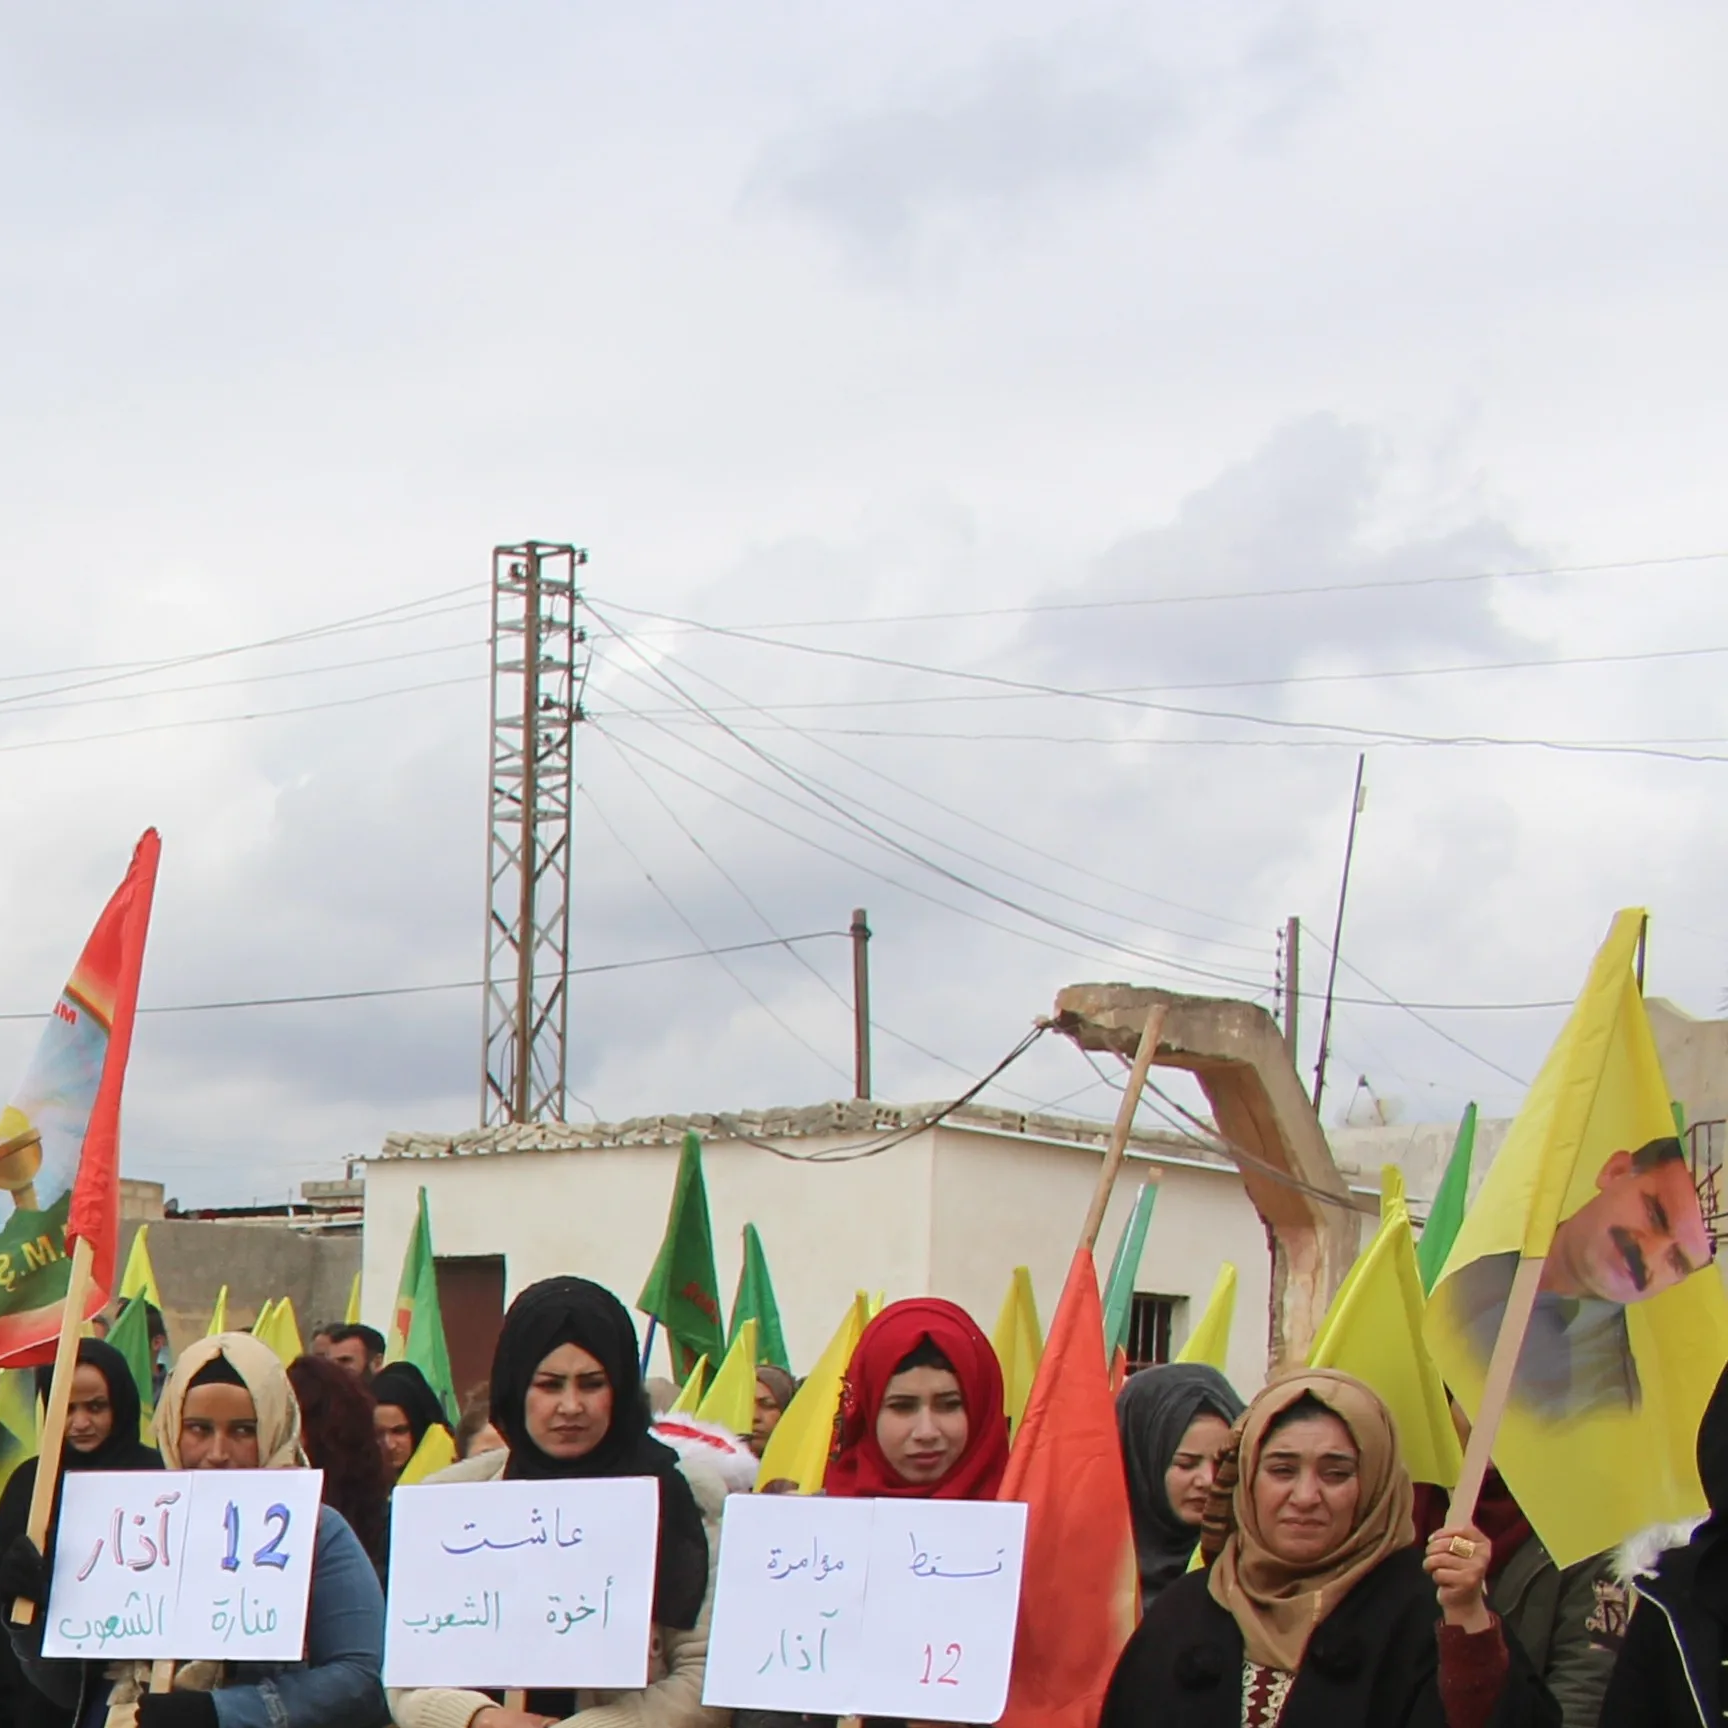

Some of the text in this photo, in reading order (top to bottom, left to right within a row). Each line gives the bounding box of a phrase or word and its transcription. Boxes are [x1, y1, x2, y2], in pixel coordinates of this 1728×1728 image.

[77, 1491, 292, 1582] 12 آذار
[440, 1507, 583, 1555] عاشت
[766, 1531, 1006, 1581] تسقط مؤامرة
[59, 1587, 278, 1650] منارة الشعوب
[402, 1575, 615, 1635] أخوة الشعوب
[757, 1608, 963, 1686] 12 آذار
